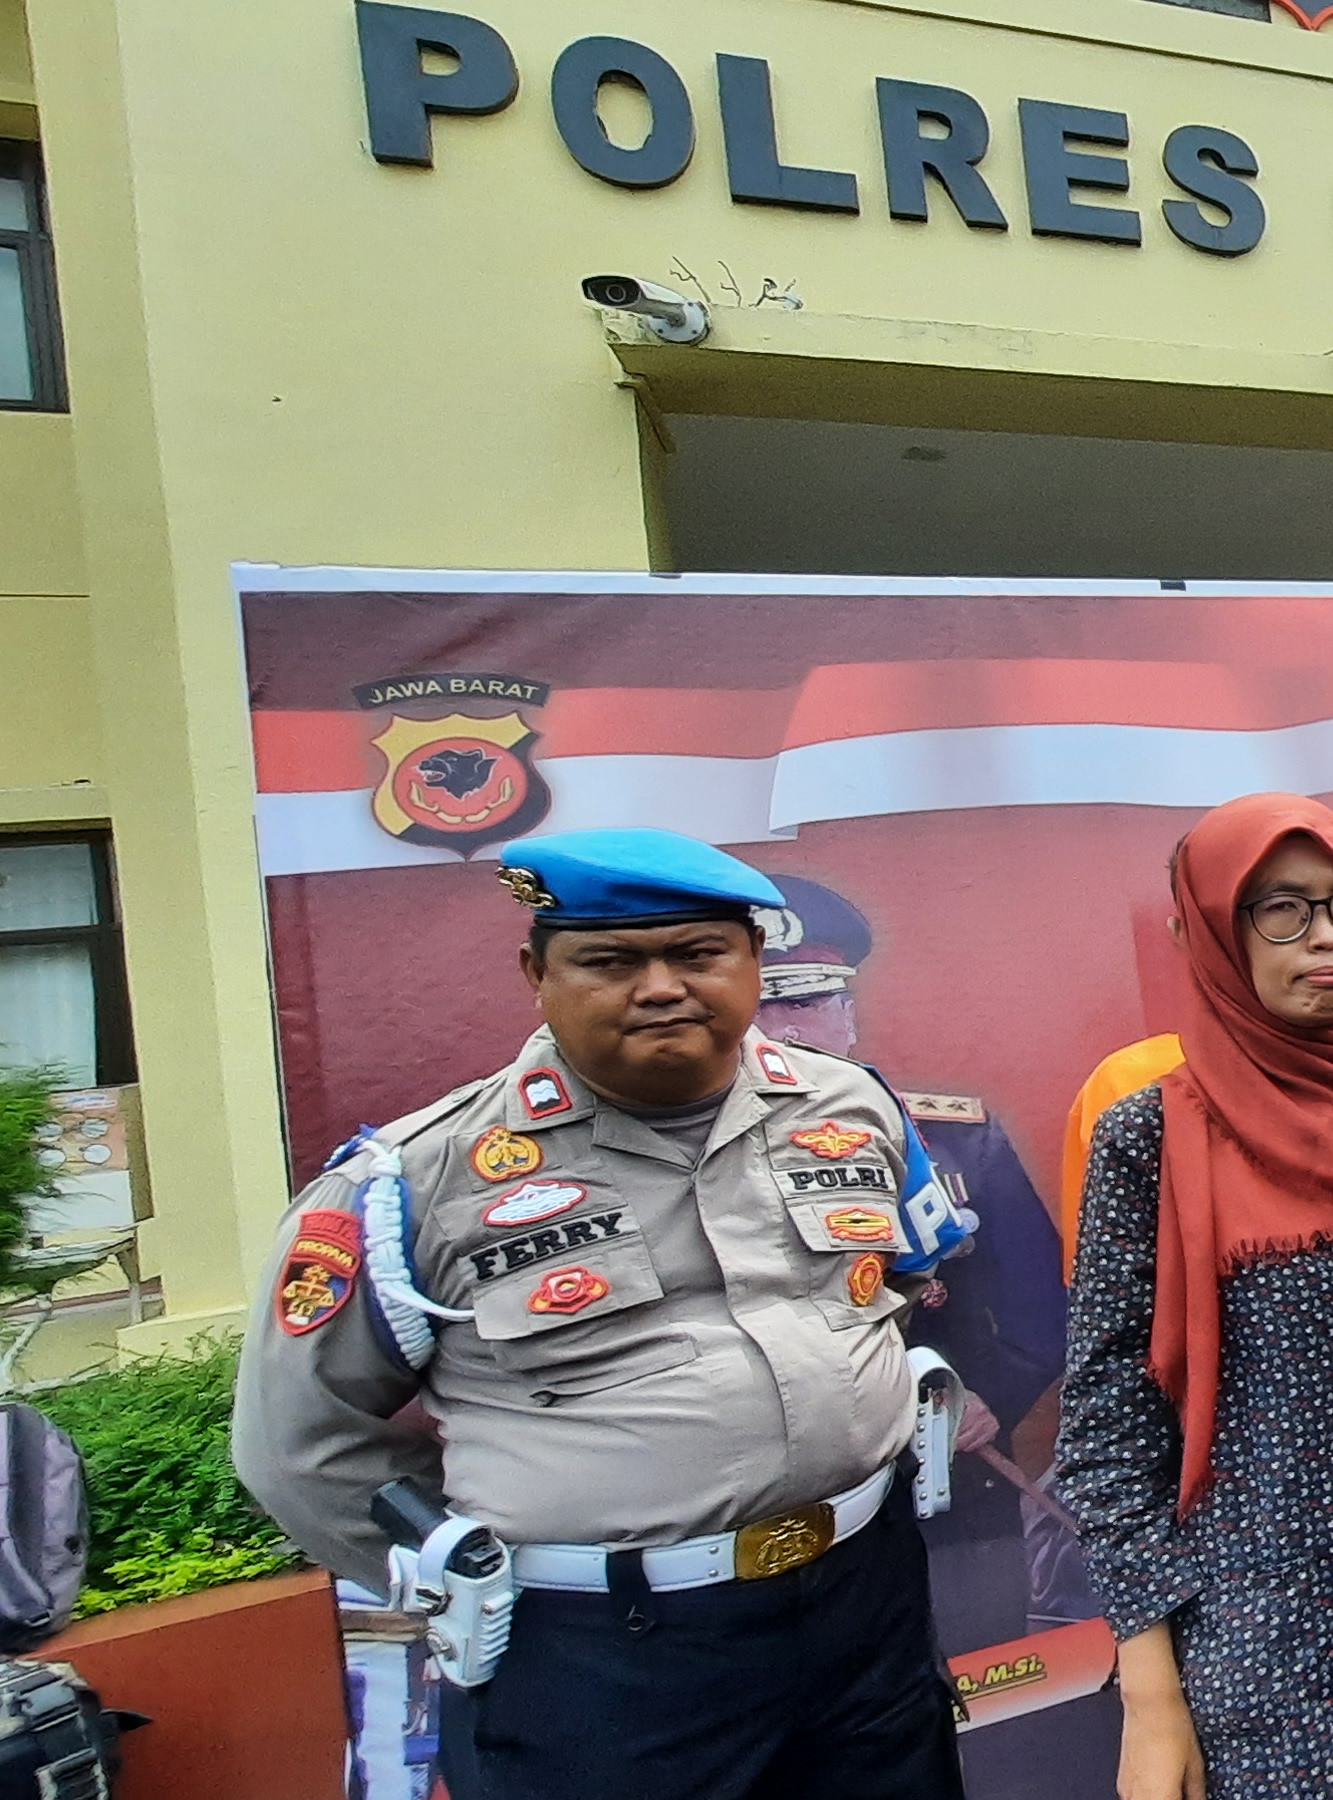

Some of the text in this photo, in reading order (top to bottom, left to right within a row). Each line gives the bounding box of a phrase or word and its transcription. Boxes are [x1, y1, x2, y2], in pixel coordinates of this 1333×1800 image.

[355, 0, 1267, 258] POLRES
[369, 679, 540, 704] JAWA BARAT
[788, 1166, 889, 1191] POLRI
[470, 1211, 623, 1282] FERRY
[984, 1654, 1045, 1686] M.Si.
